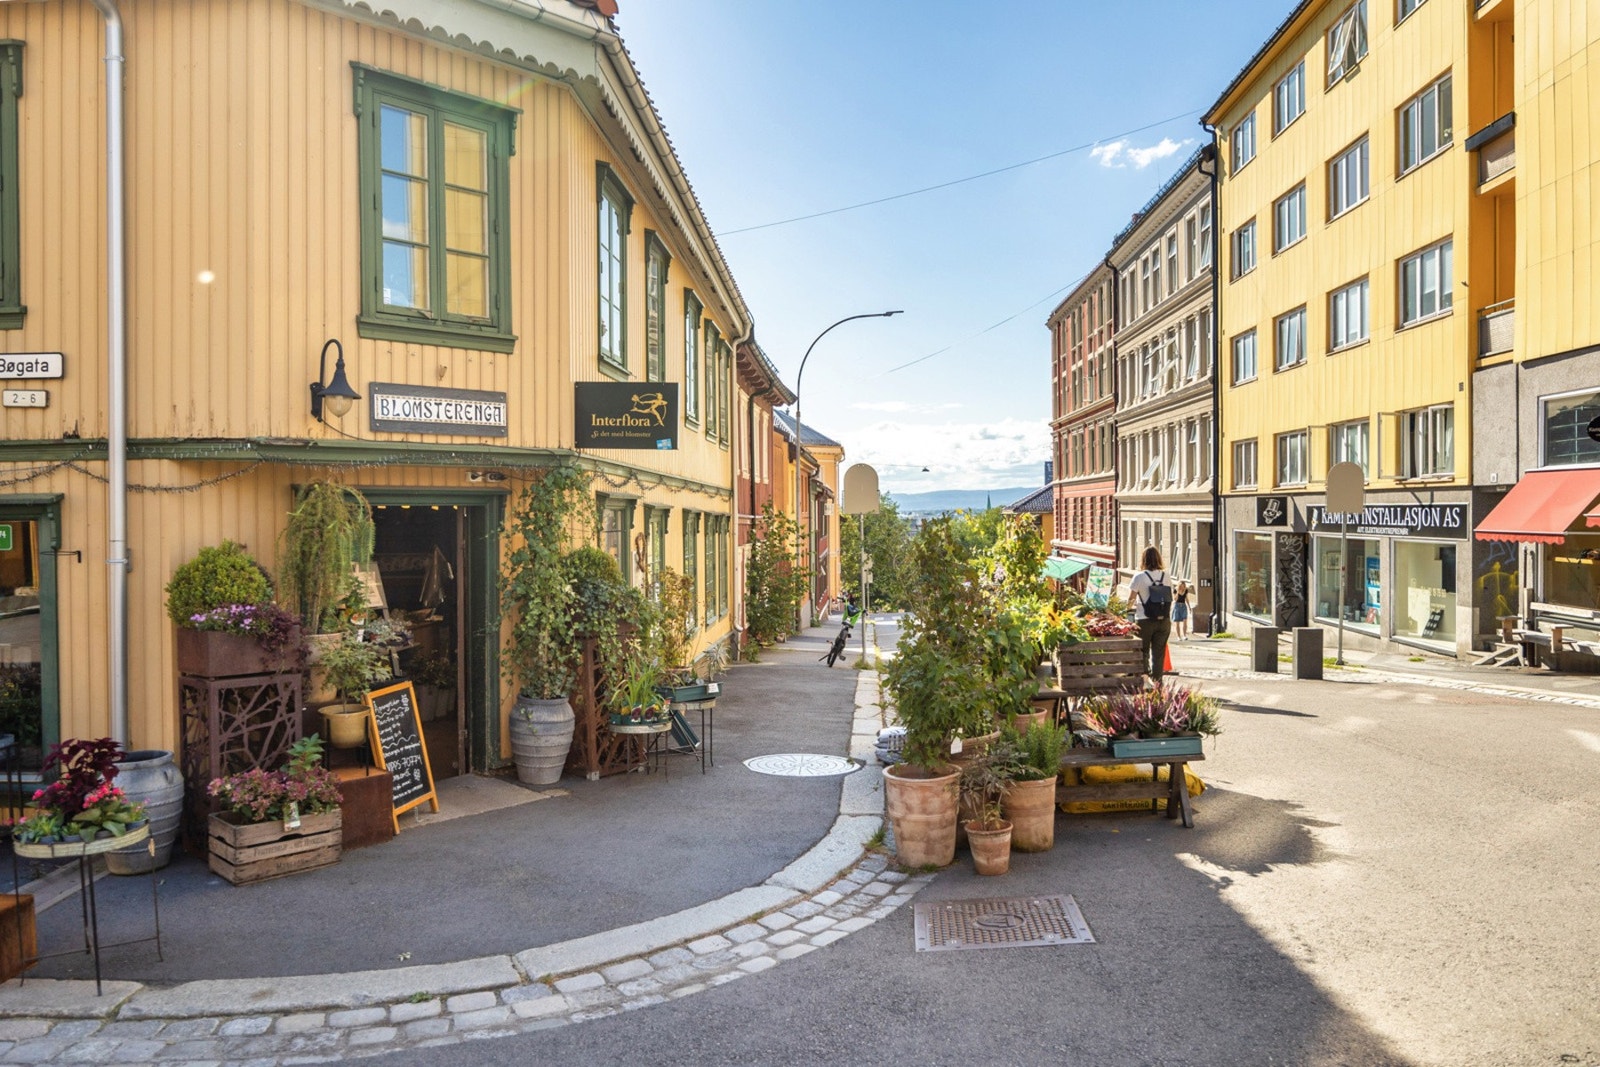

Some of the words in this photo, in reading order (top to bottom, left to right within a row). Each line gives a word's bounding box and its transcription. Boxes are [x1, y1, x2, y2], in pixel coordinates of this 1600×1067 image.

[0, 358, 49, 377] Bøgata
[380, 398, 502, 423] BLOMSTERENGA
[591, 413, 651, 427] Interflora
[600, 430, 610, 438] det
[611, 430, 624, 438] med
[625, 430, 651, 438] blomster
[1321, 507, 1359, 524] KAMEN
[1361, 507, 1440, 531] INSTALLASJON
[1443, 507, 1460, 528] AS
